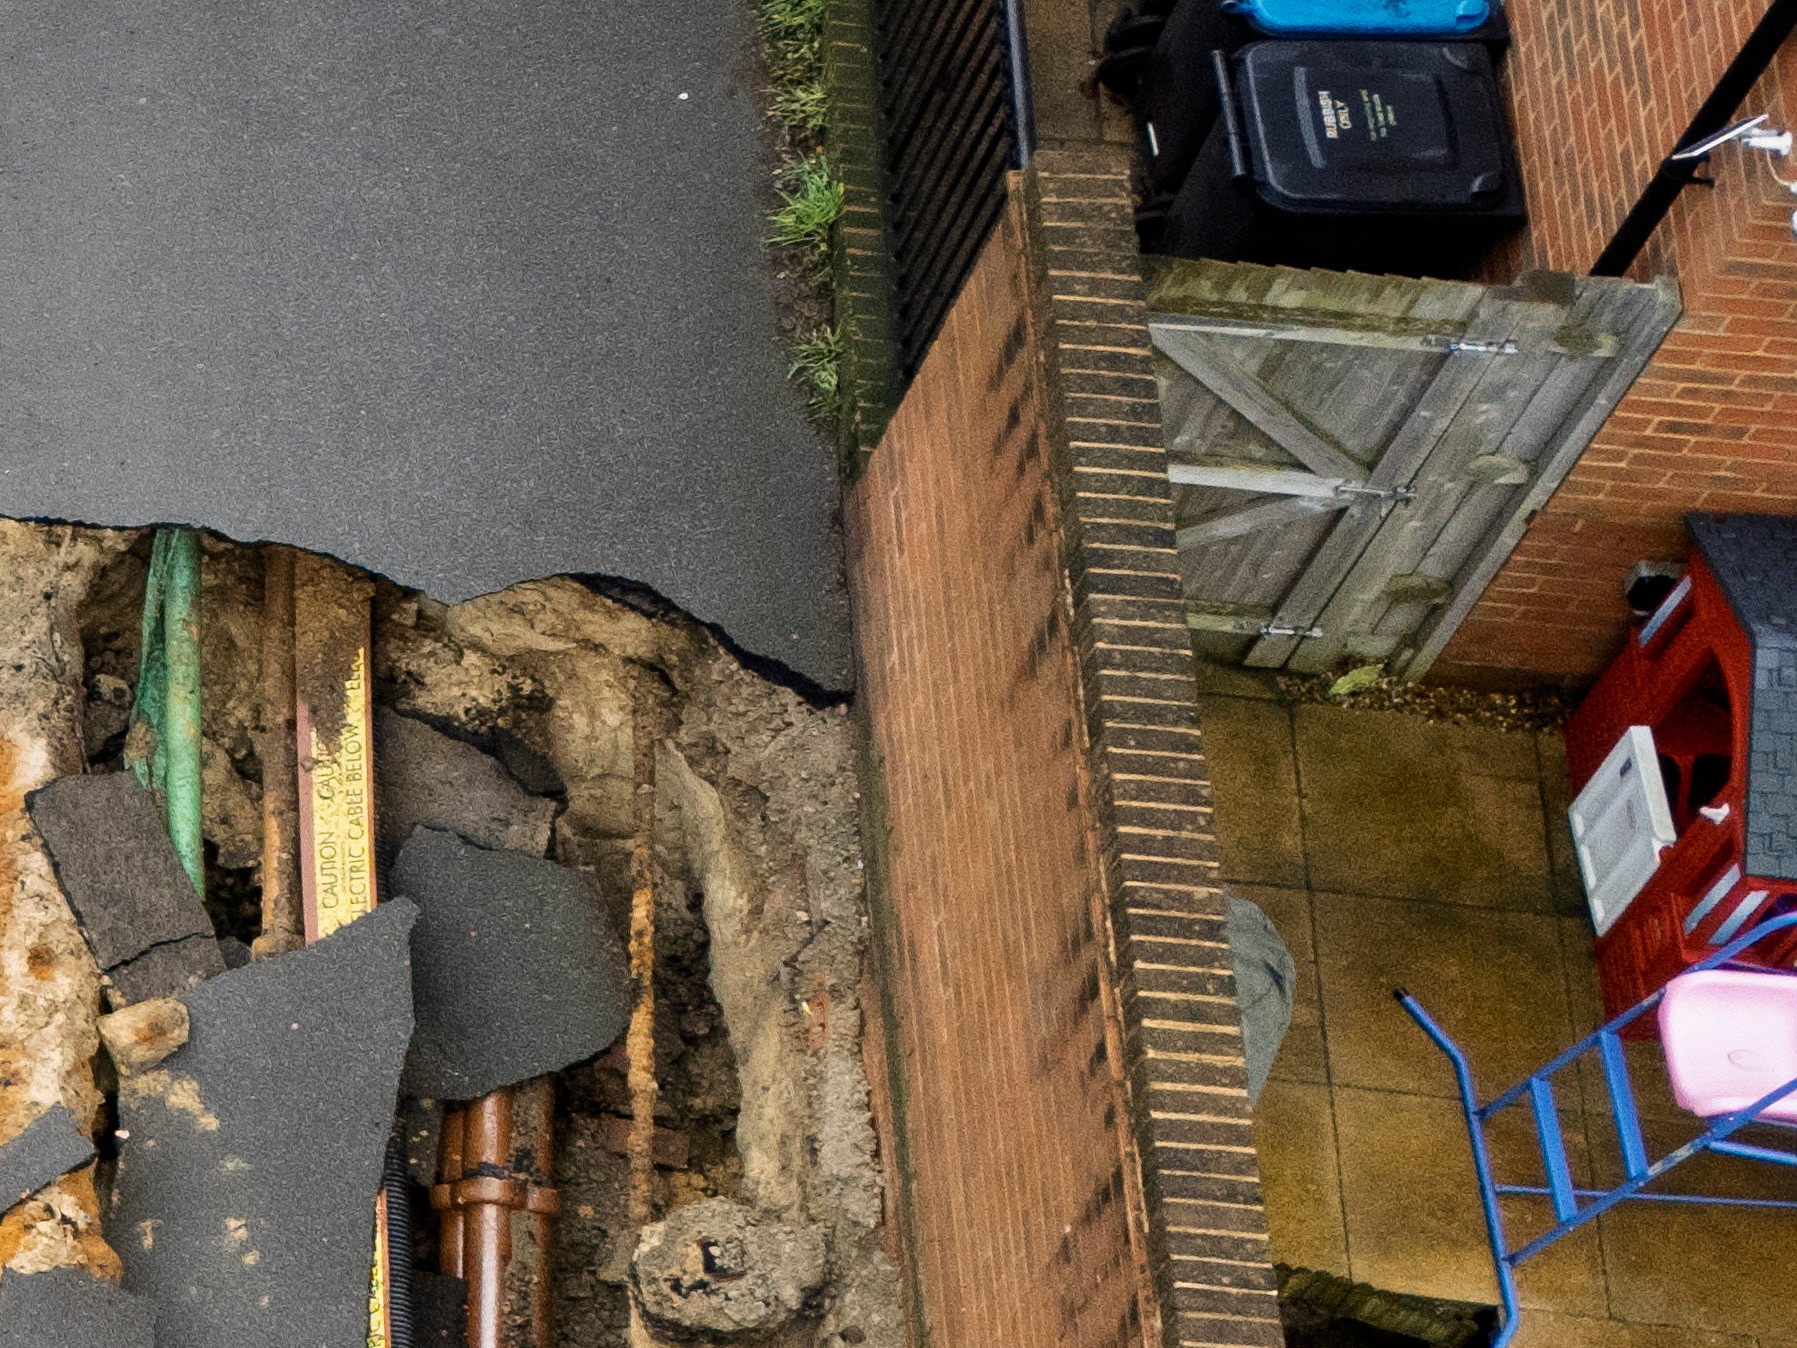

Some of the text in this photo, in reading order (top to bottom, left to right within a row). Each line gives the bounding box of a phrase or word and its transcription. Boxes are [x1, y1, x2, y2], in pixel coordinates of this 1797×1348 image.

[344, 723, 364, 782] BELOW
[345, 789, 366, 841] CABLE
[319, 831, 340, 909] CAUTION
